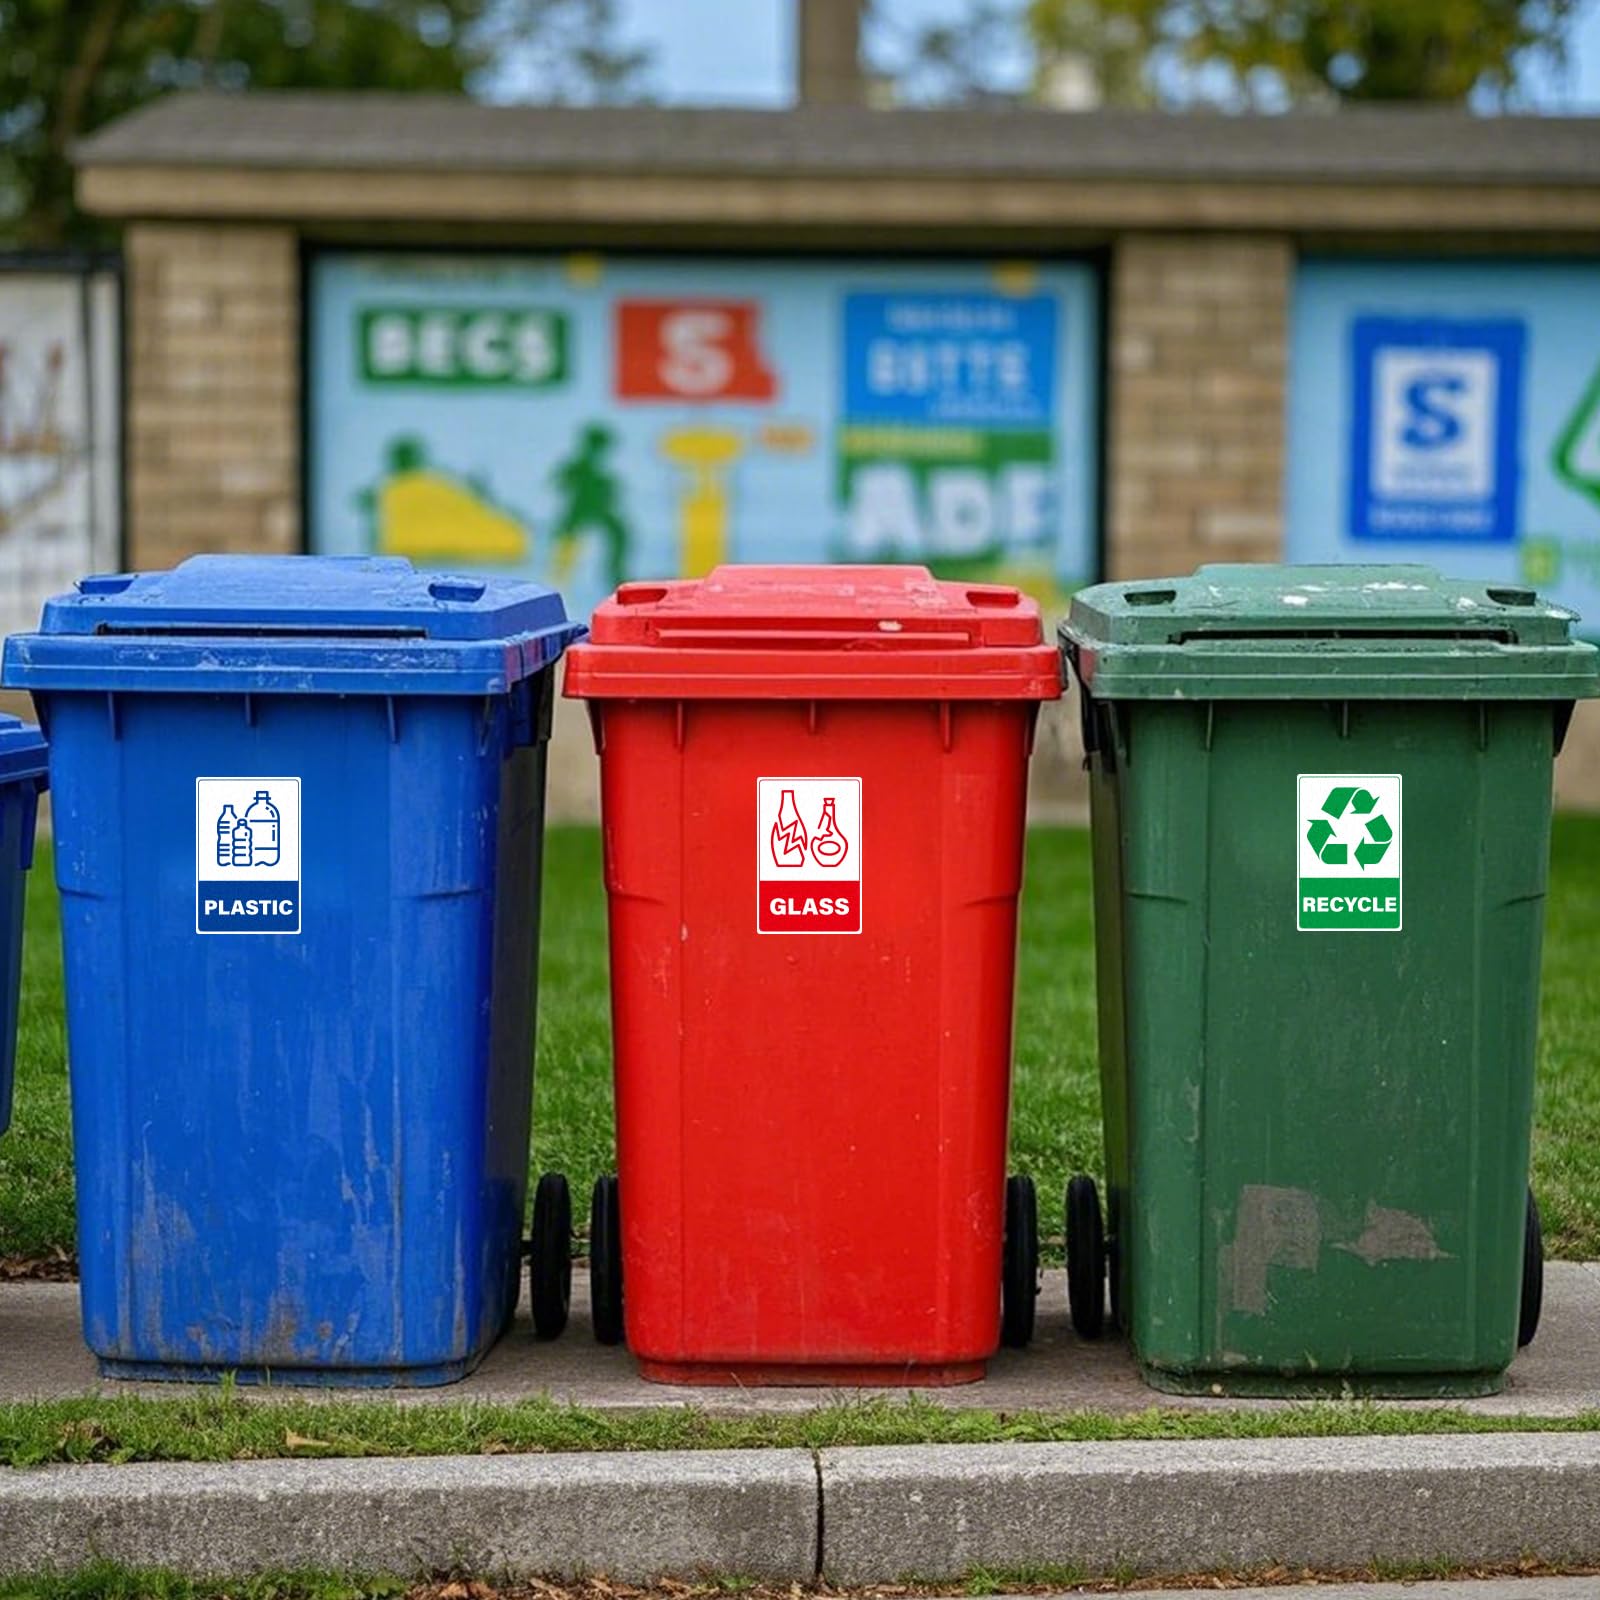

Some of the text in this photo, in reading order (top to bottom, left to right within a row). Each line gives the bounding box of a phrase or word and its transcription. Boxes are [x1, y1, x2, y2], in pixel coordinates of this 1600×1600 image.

[657, 311, 734, 398] S
[1402, 374, 1467, 449] S
[204, 899, 294, 916] PLASTIC
[769, 897, 850, 916] GLASS
[1302, 896, 1397, 913] RECYCLE
